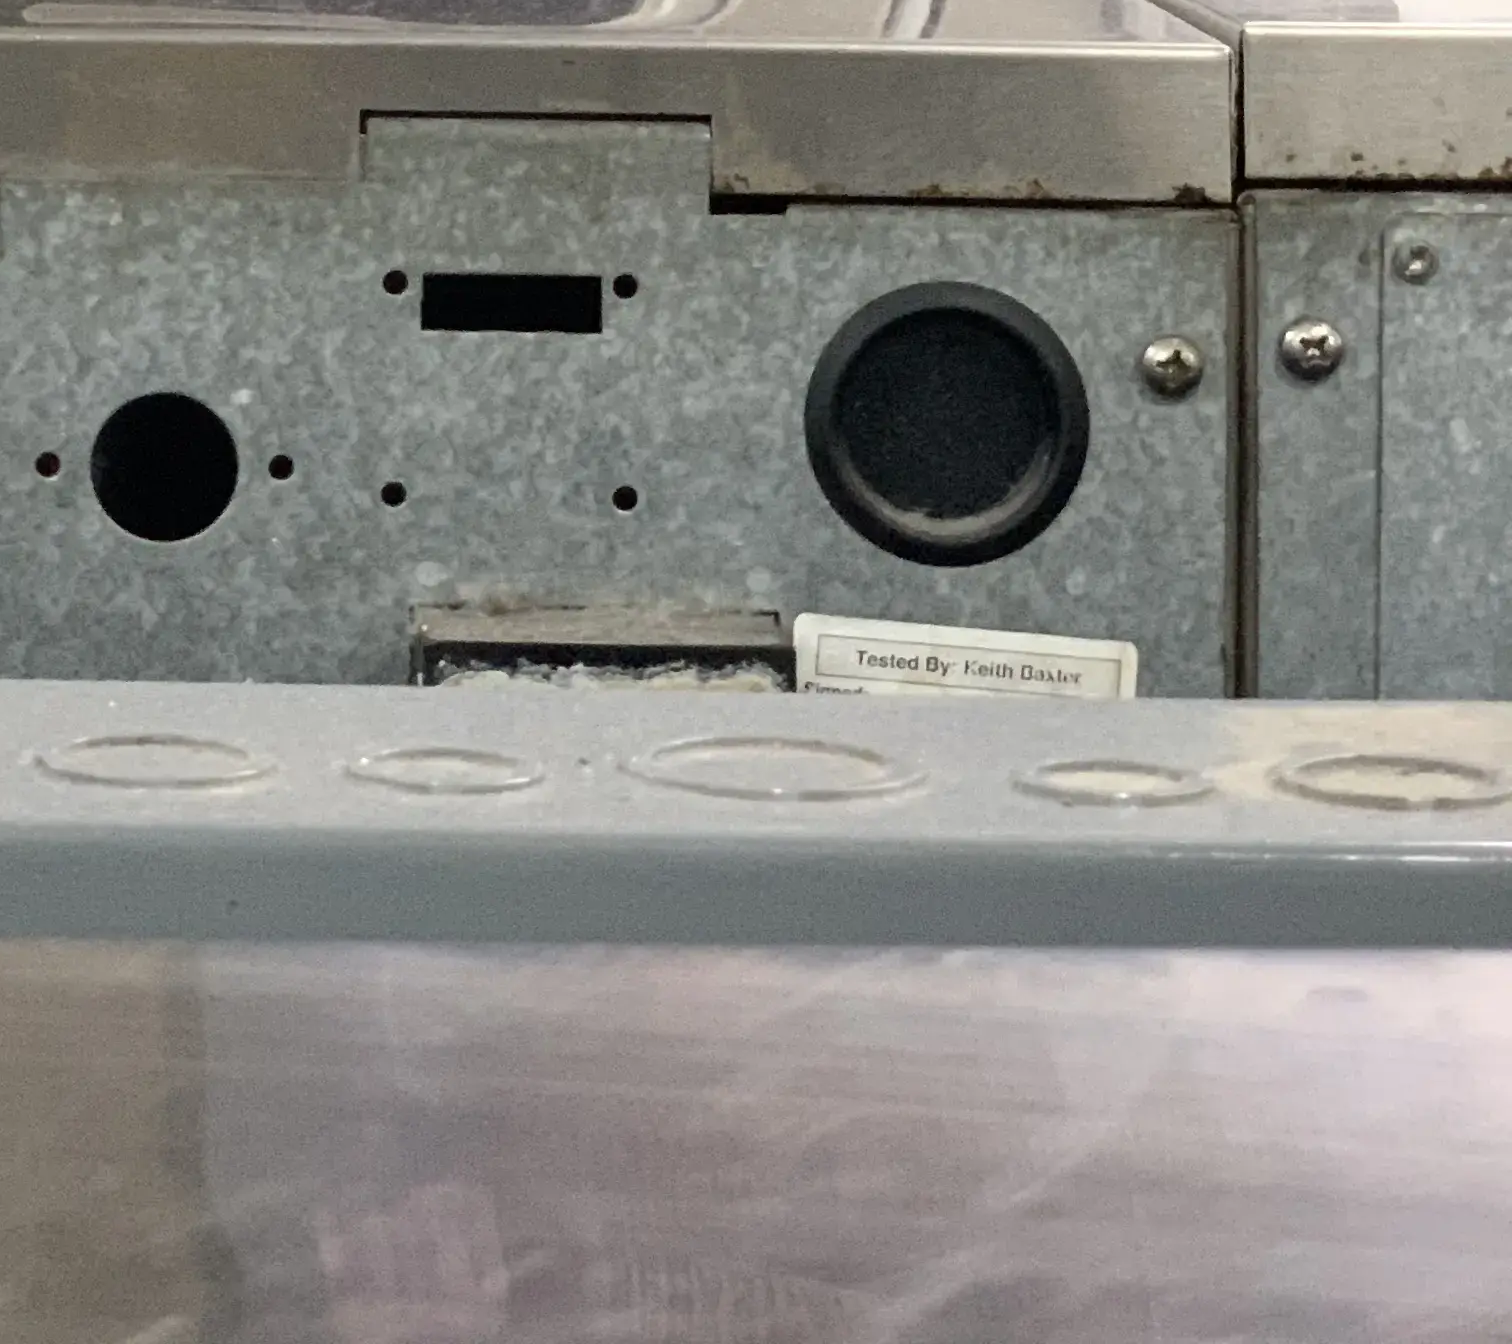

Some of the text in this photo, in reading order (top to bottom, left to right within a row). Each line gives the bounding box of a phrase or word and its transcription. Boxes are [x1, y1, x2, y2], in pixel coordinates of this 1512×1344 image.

[857, 650, 919, 670] Tested
[964, 660, 1013, 680] Keith
[1020, 665, 1081, 684] Baxter
